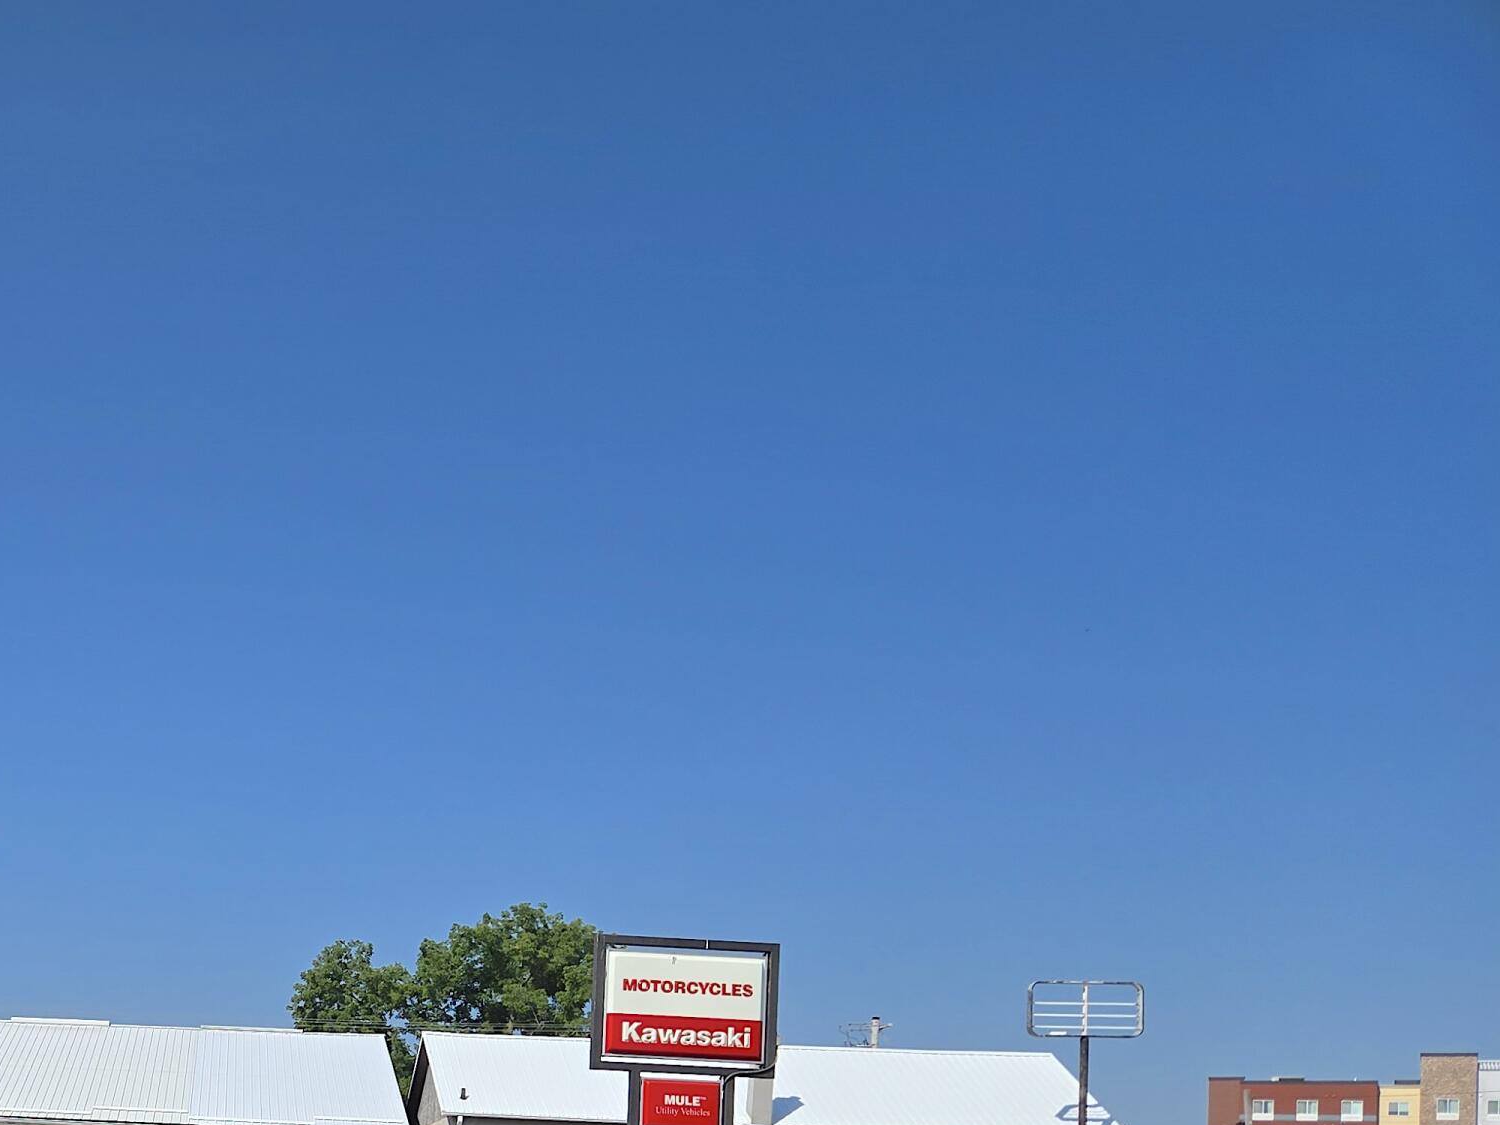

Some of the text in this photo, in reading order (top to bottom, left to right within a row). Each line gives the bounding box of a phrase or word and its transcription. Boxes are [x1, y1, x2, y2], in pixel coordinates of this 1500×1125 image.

[622, 978, 754, 997] MOTORCYCLES
[621, 1021, 751, 1049] Kawasaki
[655, 1106, 710, 1117] Utility Vehicles
